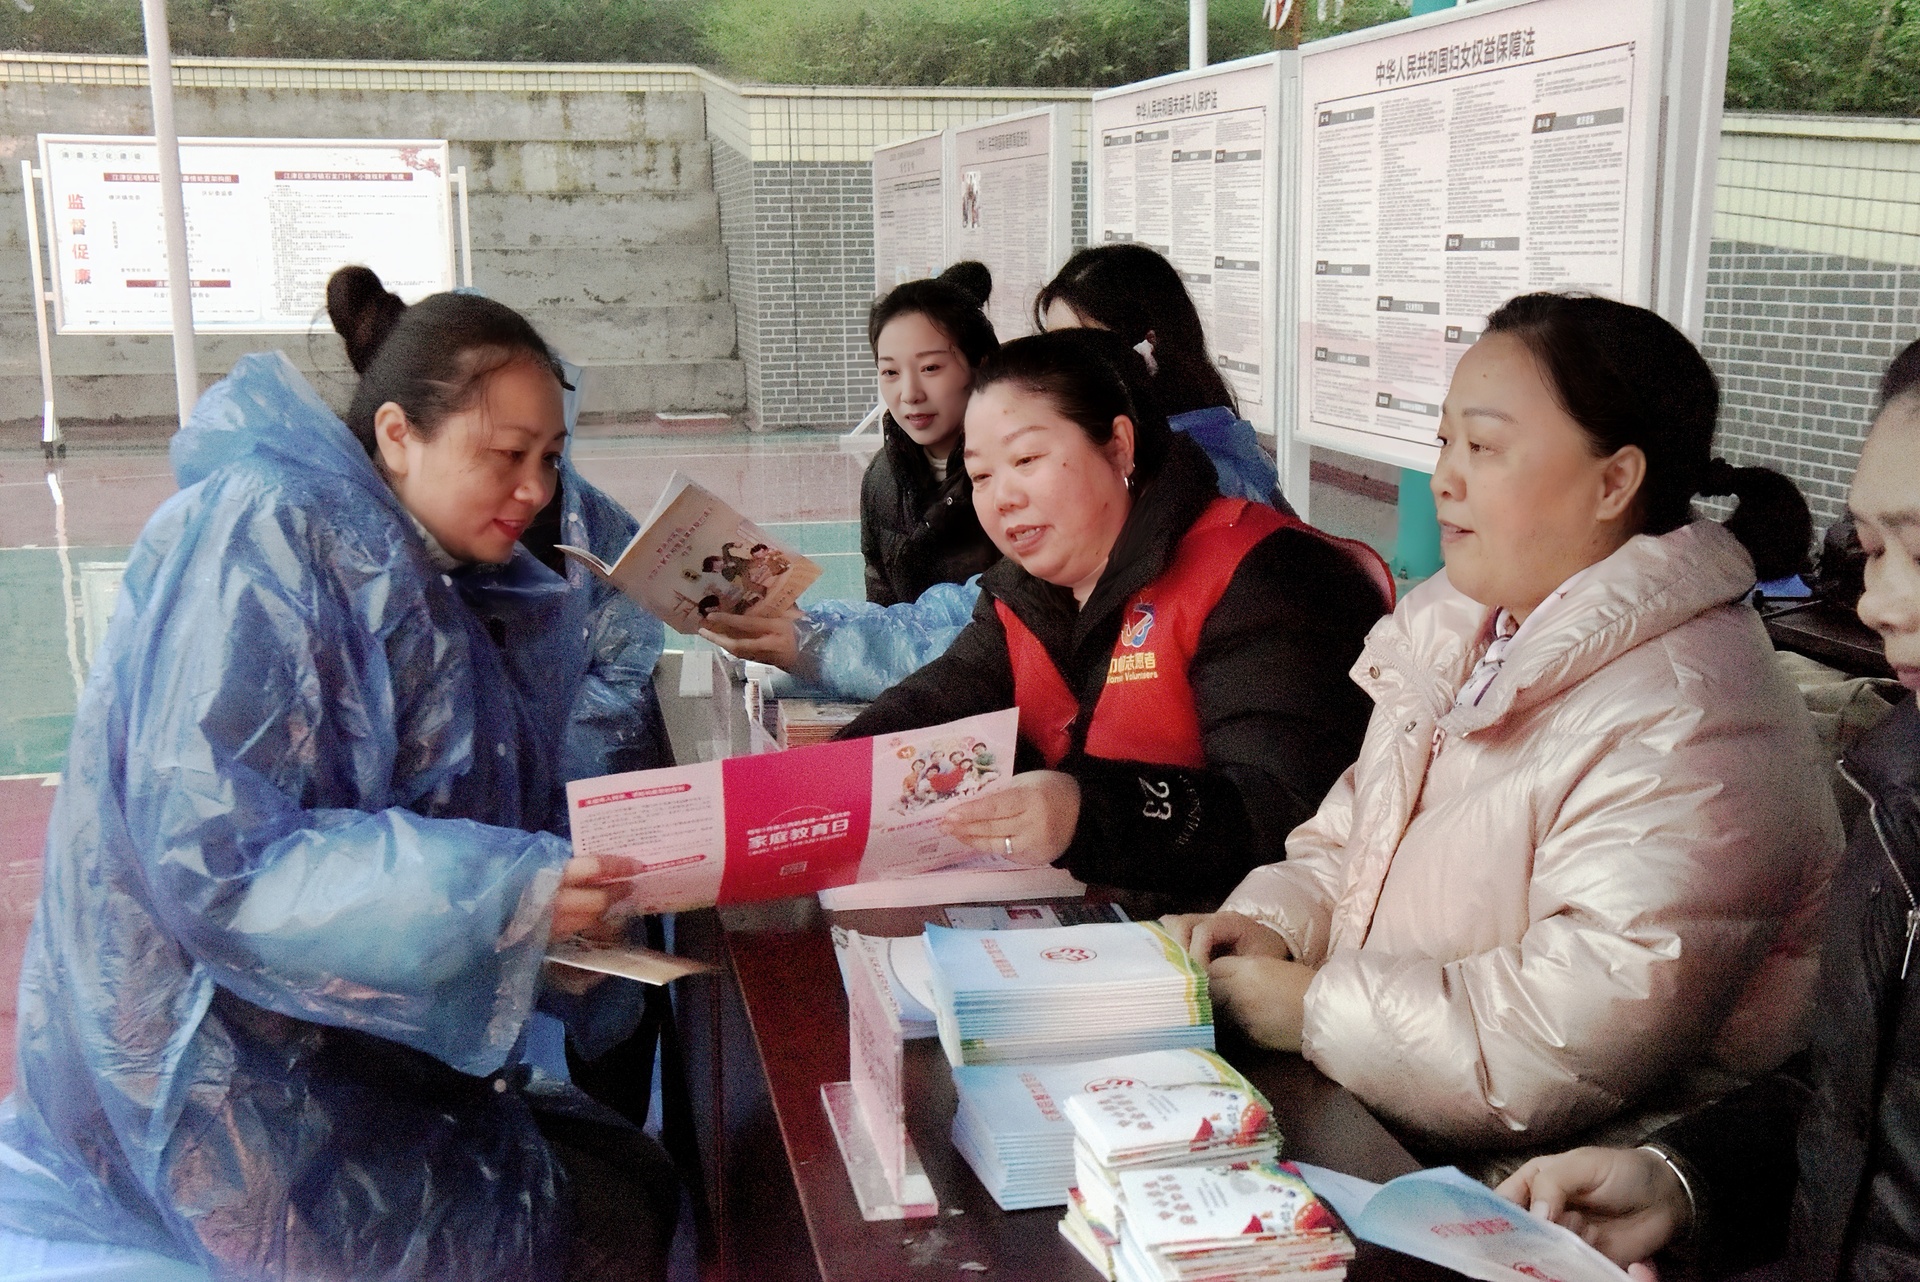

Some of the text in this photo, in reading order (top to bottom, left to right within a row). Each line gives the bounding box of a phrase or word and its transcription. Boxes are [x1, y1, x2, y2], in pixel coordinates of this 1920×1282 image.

[1375, 27, 1536, 87] 中华人民共和国妇女权益保障法
[1138, 775, 1172, 821] 23
[747, 818, 849, 849] 家庭教育日
